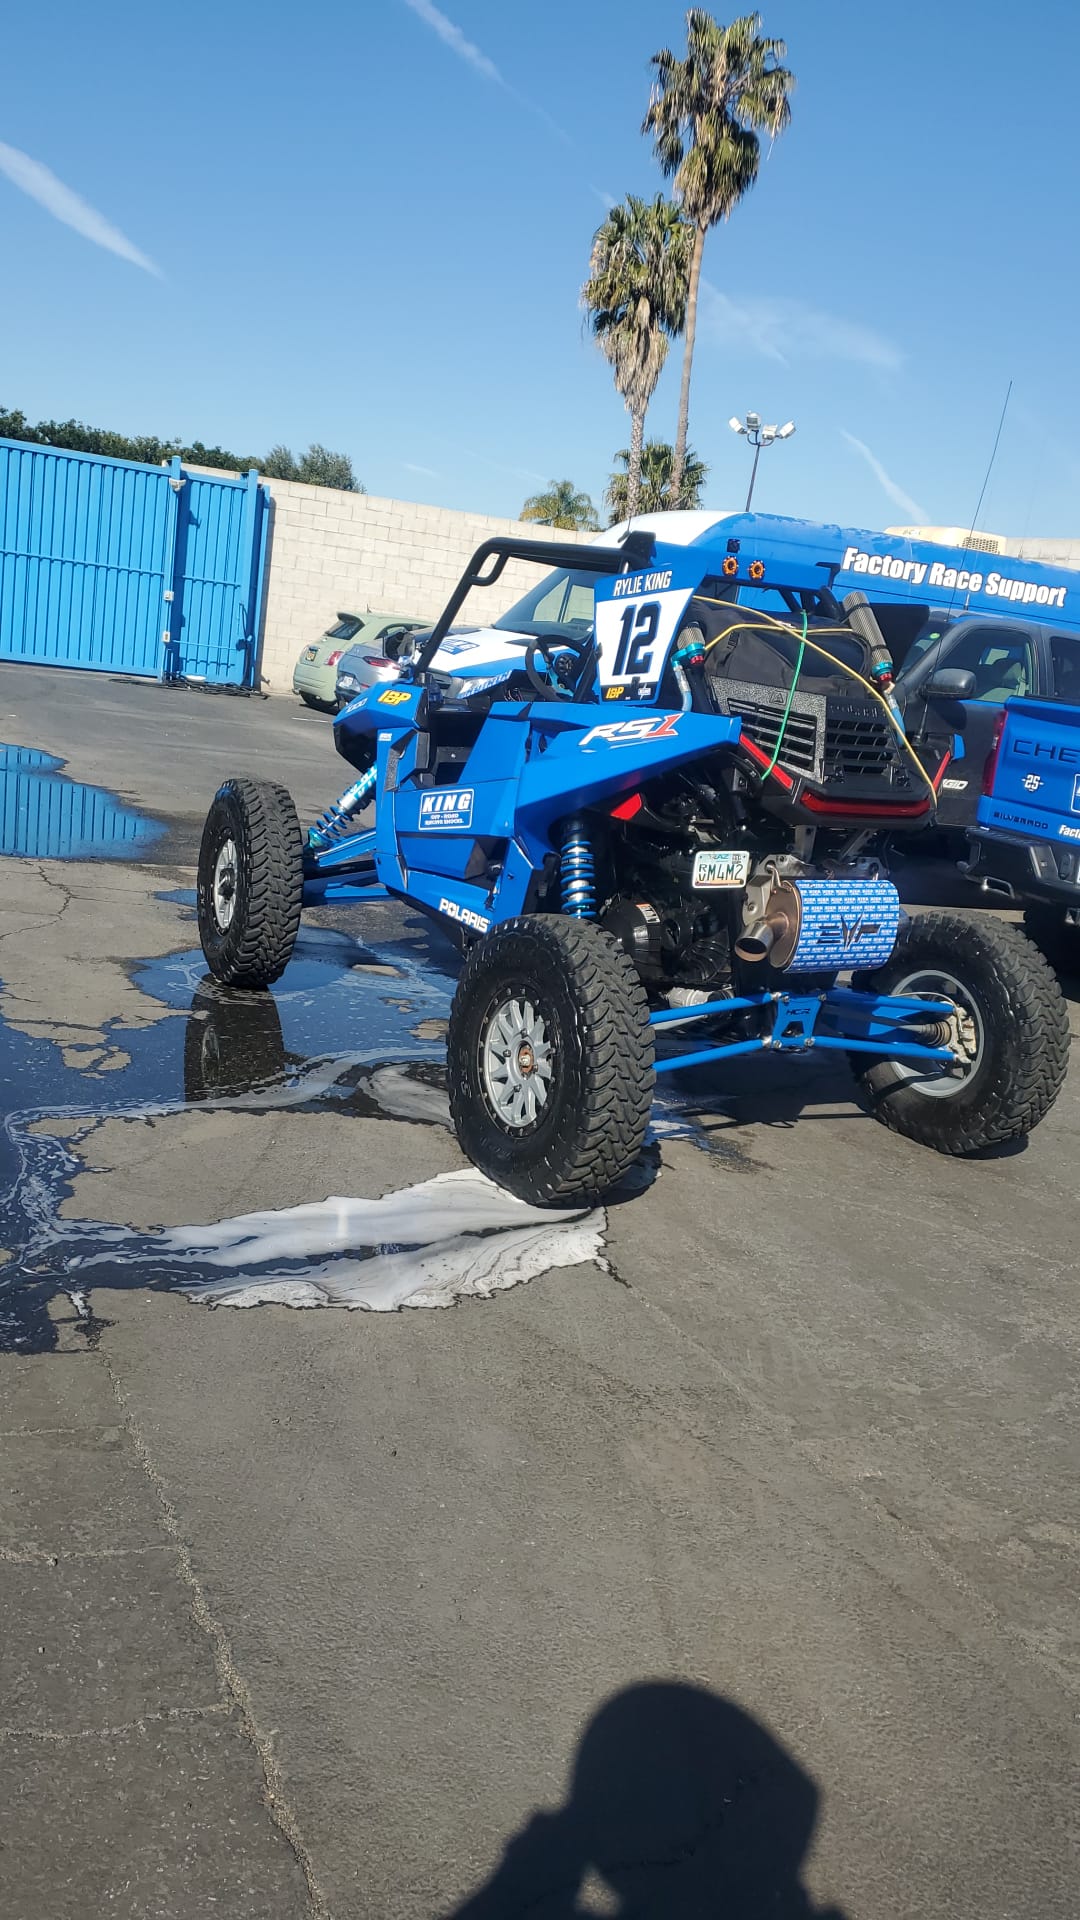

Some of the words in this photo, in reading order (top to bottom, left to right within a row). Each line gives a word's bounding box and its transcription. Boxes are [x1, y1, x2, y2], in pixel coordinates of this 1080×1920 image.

[613, 575, 643, 597] RYLIE
[644, 570, 672, 589] KING
[841, 546, 928, 585] Factory
[928, 561, 984, 592] Race
[985, 572, 1068, 608] Support
[612, 601, 661, 676] 12
[578, 712, 684, 746] RS1
[1024, 773, 1041, 791] 25
[423, 793, 471, 812] KING
[438, 897, 489, 934] POLARIS
